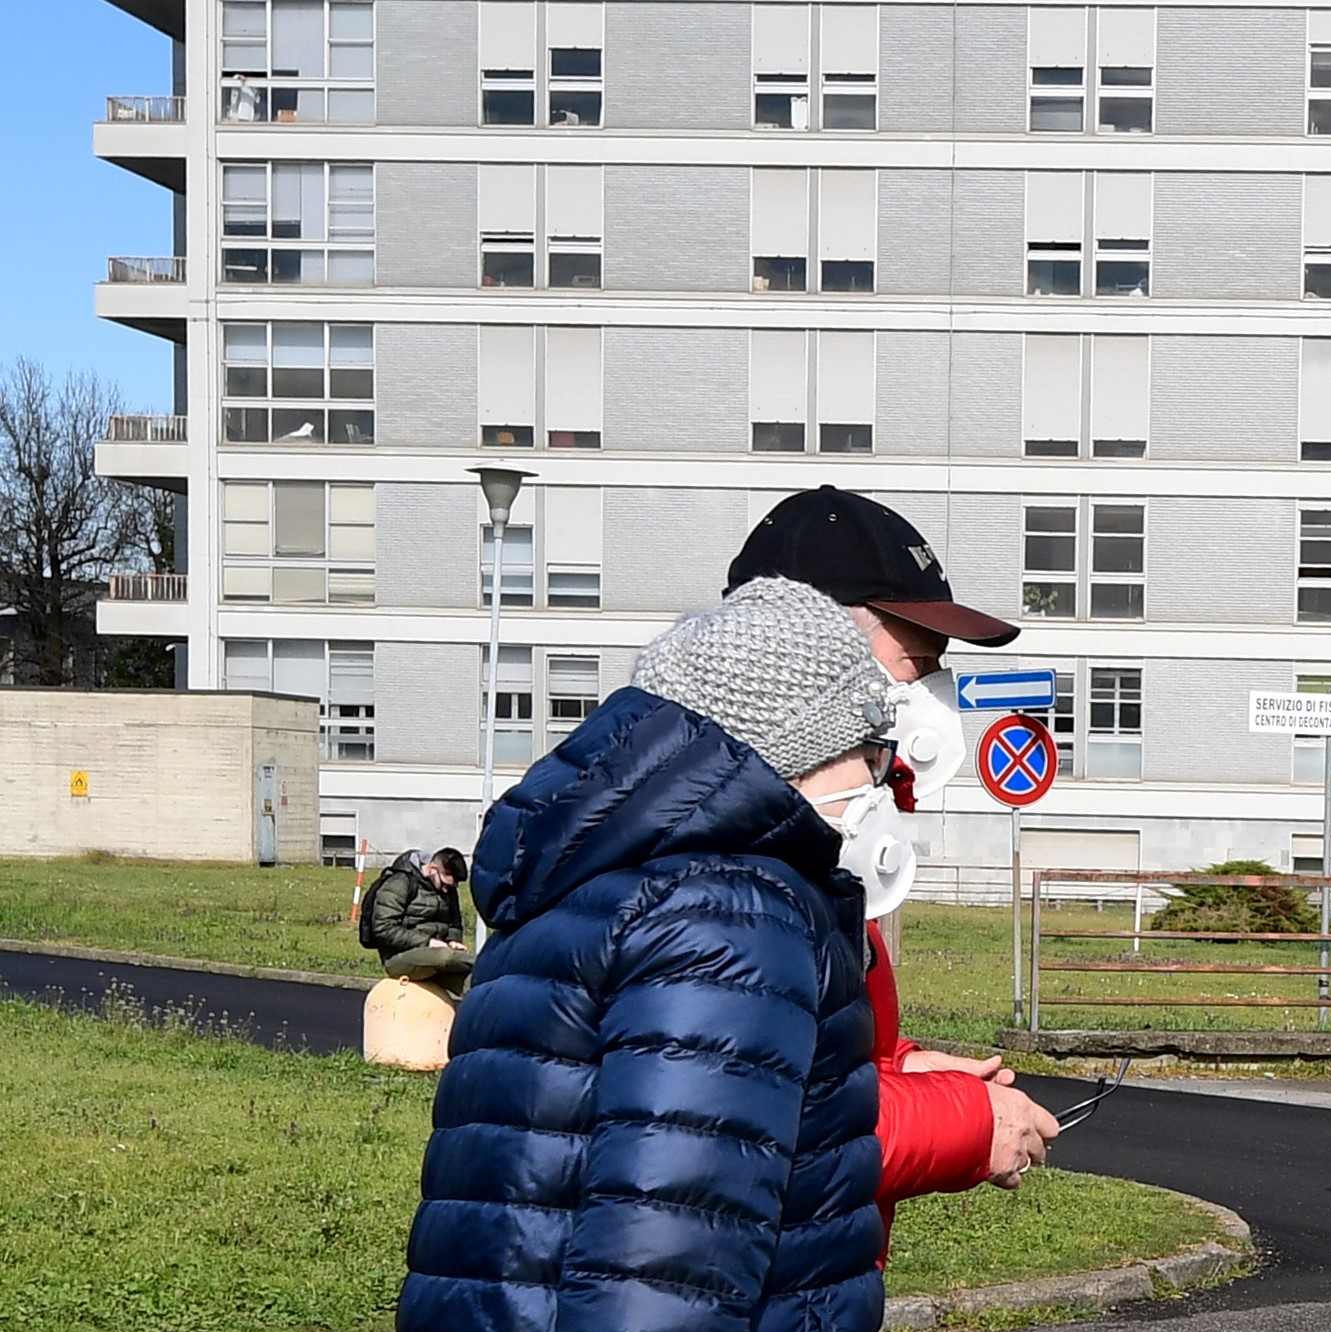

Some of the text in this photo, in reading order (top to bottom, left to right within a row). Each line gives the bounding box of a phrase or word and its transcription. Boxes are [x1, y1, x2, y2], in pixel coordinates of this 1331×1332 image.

[1255, 698, 1302, 712] SERVIZIO
[1306, 700, 1316, 713] DI
[1255, 715, 1286, 727] CENTRO
[1289, 716, 1297, 728] DI
